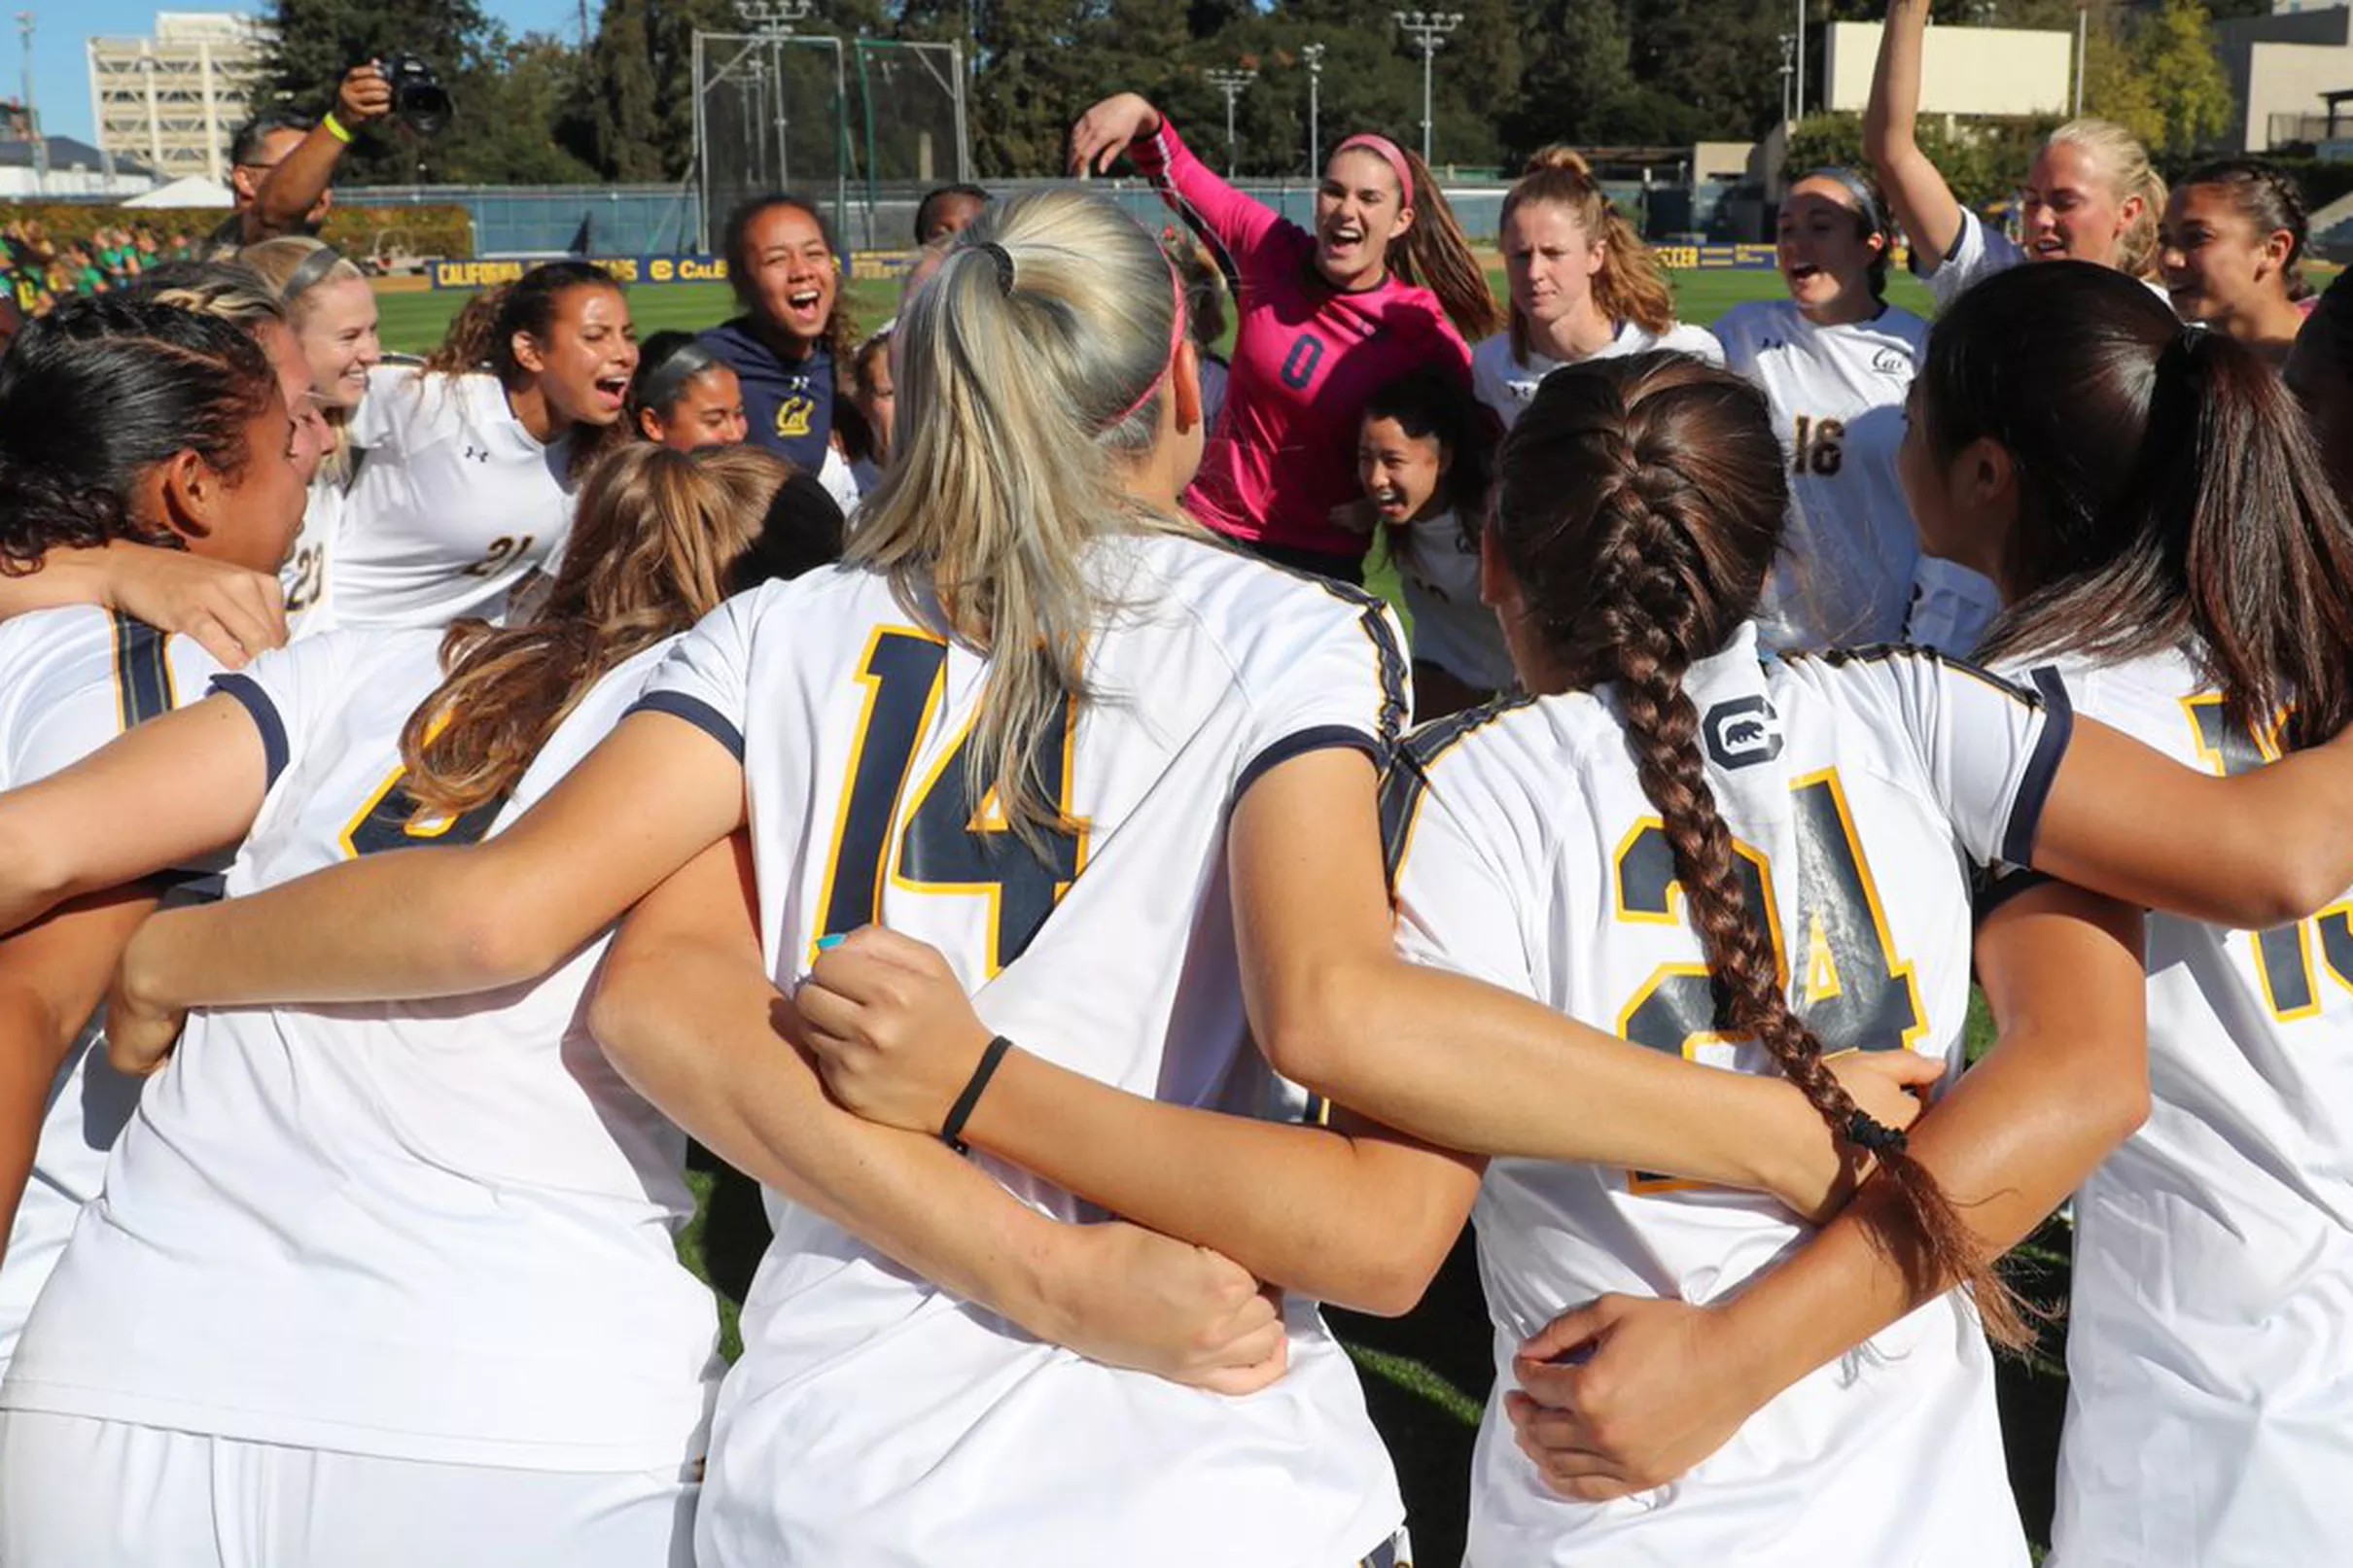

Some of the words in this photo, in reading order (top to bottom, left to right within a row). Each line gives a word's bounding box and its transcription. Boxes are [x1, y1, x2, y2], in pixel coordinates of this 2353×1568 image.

[1281, 334, 1323, 390] 0
[778, 396, 815, 436] Cal
[1793, 412, 1845, 476] 16
[461, 536, 534, 578] 21
[809, 624, 1092, 981] 14
[1612, 765, 1930, 1196] 24
